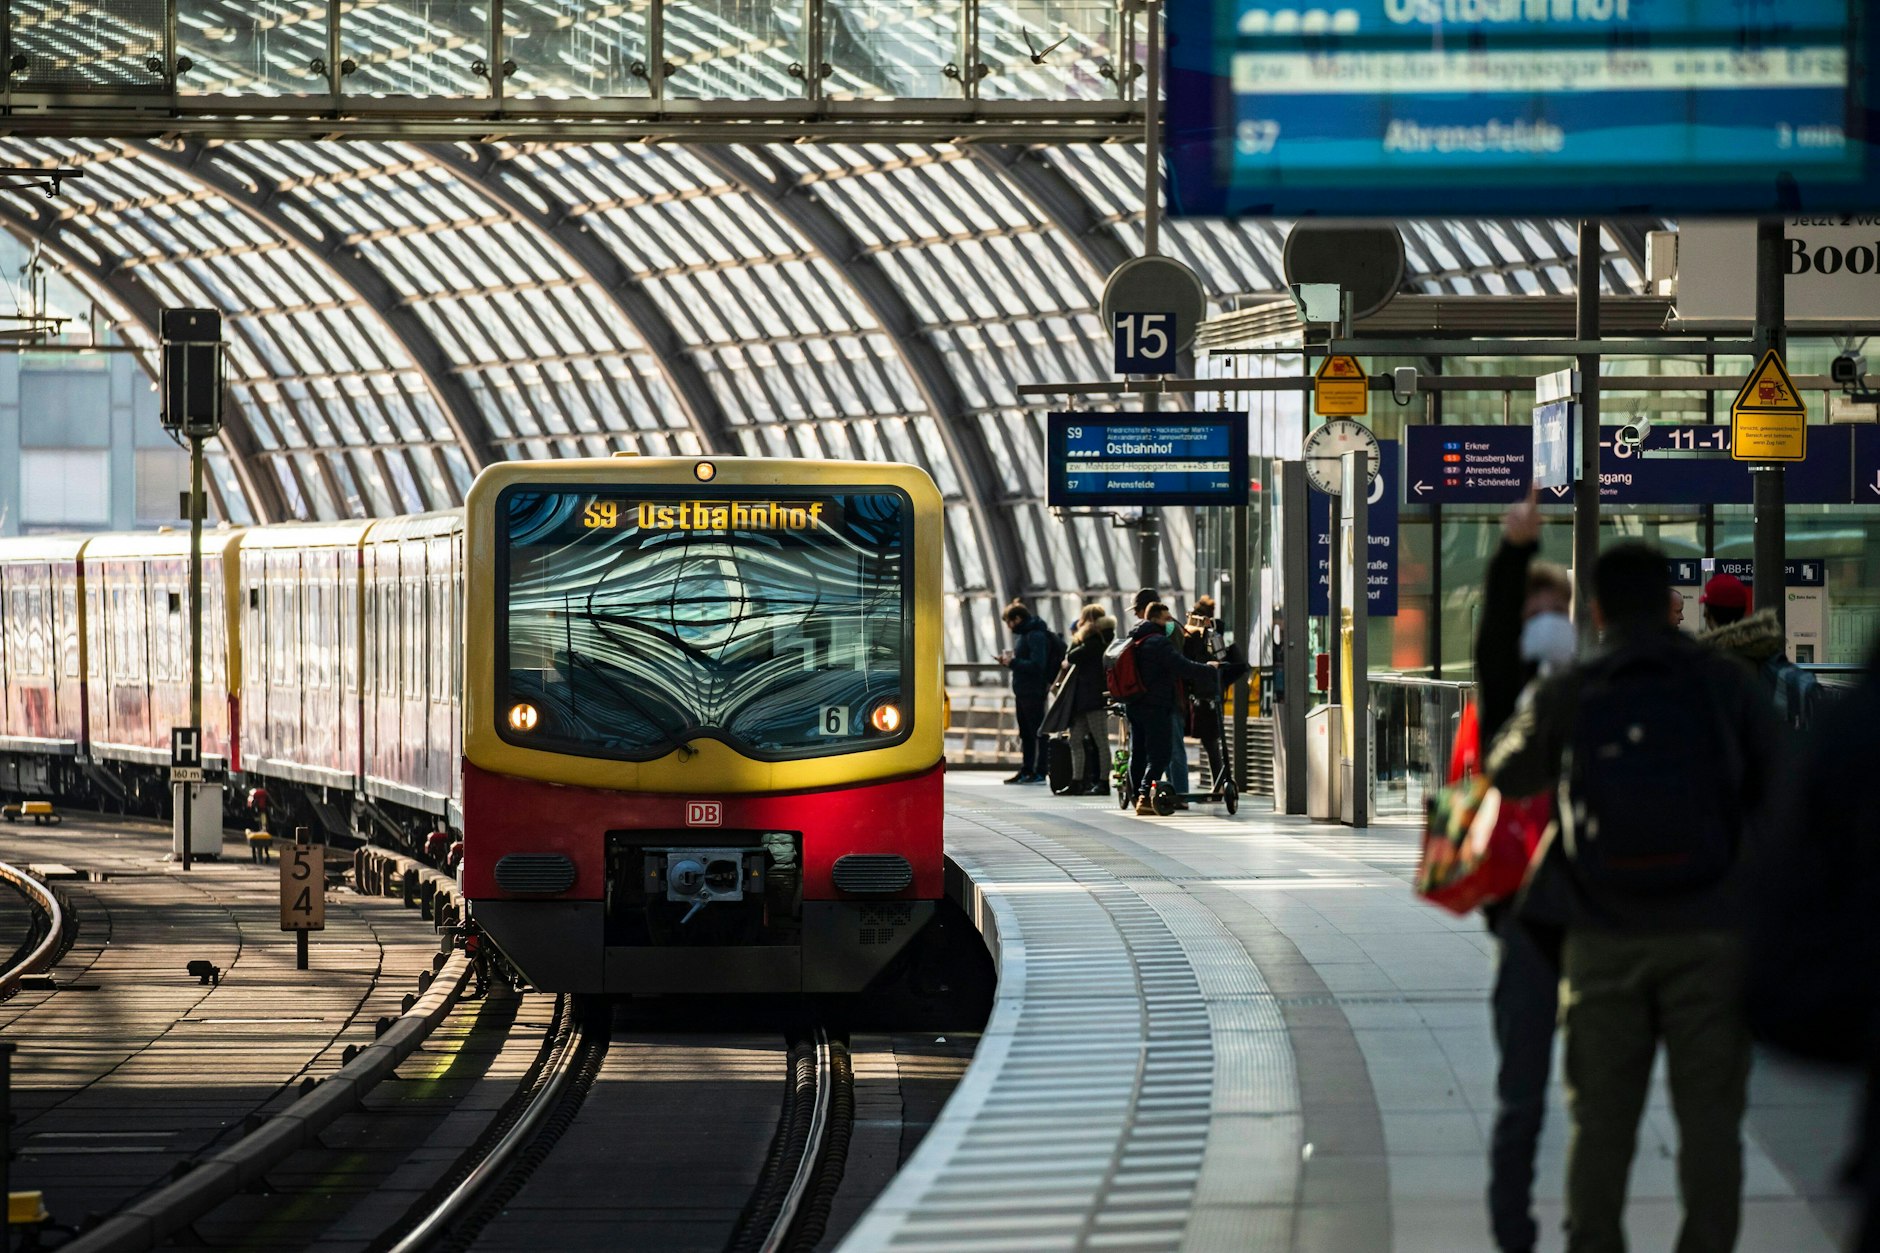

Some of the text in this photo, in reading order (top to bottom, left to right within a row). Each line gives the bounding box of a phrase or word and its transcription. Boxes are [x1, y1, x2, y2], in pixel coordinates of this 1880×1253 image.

[1237, 119, 1280, 155] S7
[1383, 118, 1565, 153] Ahrensfelde
[1783, 238, 1880, 275] Boo
[1117, 315, 1168, 359] 15
[1067, 427, 1083, 439] S9
[1668, 428, 1732, 450] 11-1
[1107, 442, 1173, 455] Ostbahnhof
[1464, 442, 1490, 450] Erkner
[1465, 454, 1505, 464] Strausberg
[1506, 454, 1525, 462] Nord
[1465, 466, 1511, 474] Ahrensfelde
[1599, 473, 1633, 485] sgang
[1067, 480, 1079, 489] S7
[1107, 480, 1155, 489] Ahrensfelde
[1477, 478, 1521, 486] Schönefeld
[584, 501, 824, 530] S9 Ostbahnhof
[825, 706, 841, 734] 6
[176, 732, 198, 762] H
[173, 769, 200, 779] 160 m
[689, 804, 719, 824] DB
[292, 851, 311, 881] 5
[293, 886, 312, 916] 4
